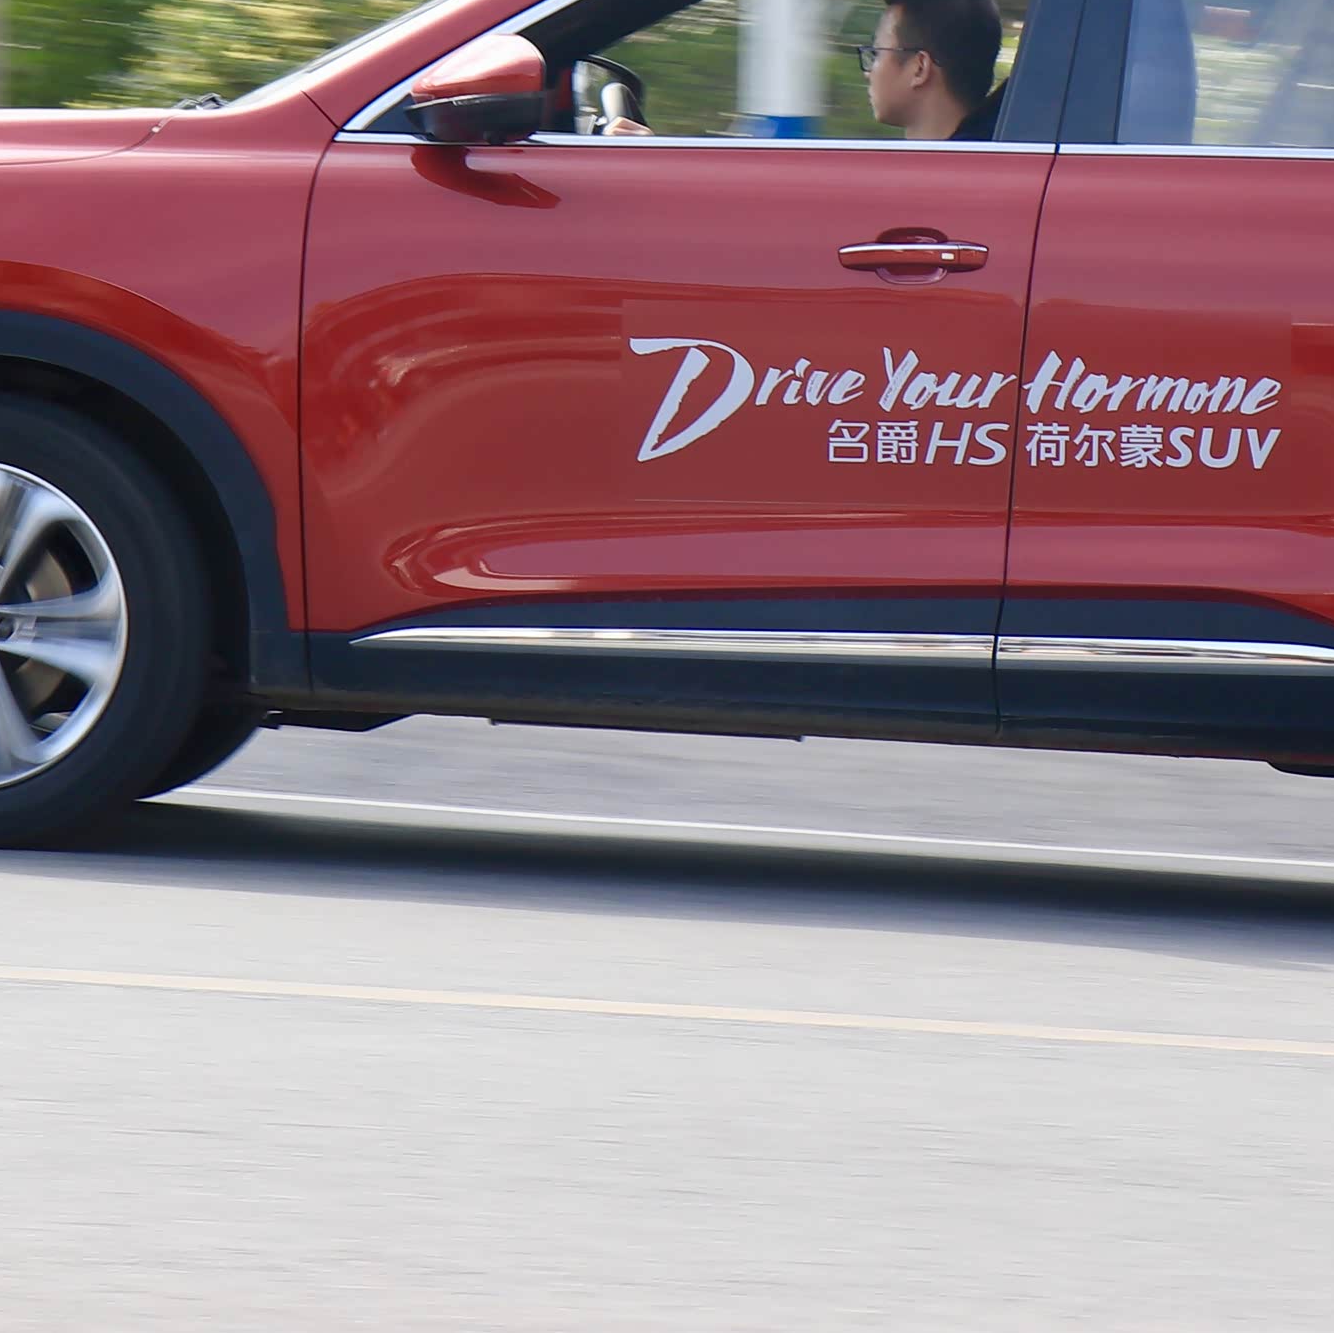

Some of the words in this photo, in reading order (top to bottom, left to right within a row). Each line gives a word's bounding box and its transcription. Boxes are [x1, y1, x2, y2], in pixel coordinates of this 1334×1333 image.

[629, 337, 866, 462] Drive
[878, 347, 1017, 412] Your
[1022, 351, 1281, 415] Hormone
